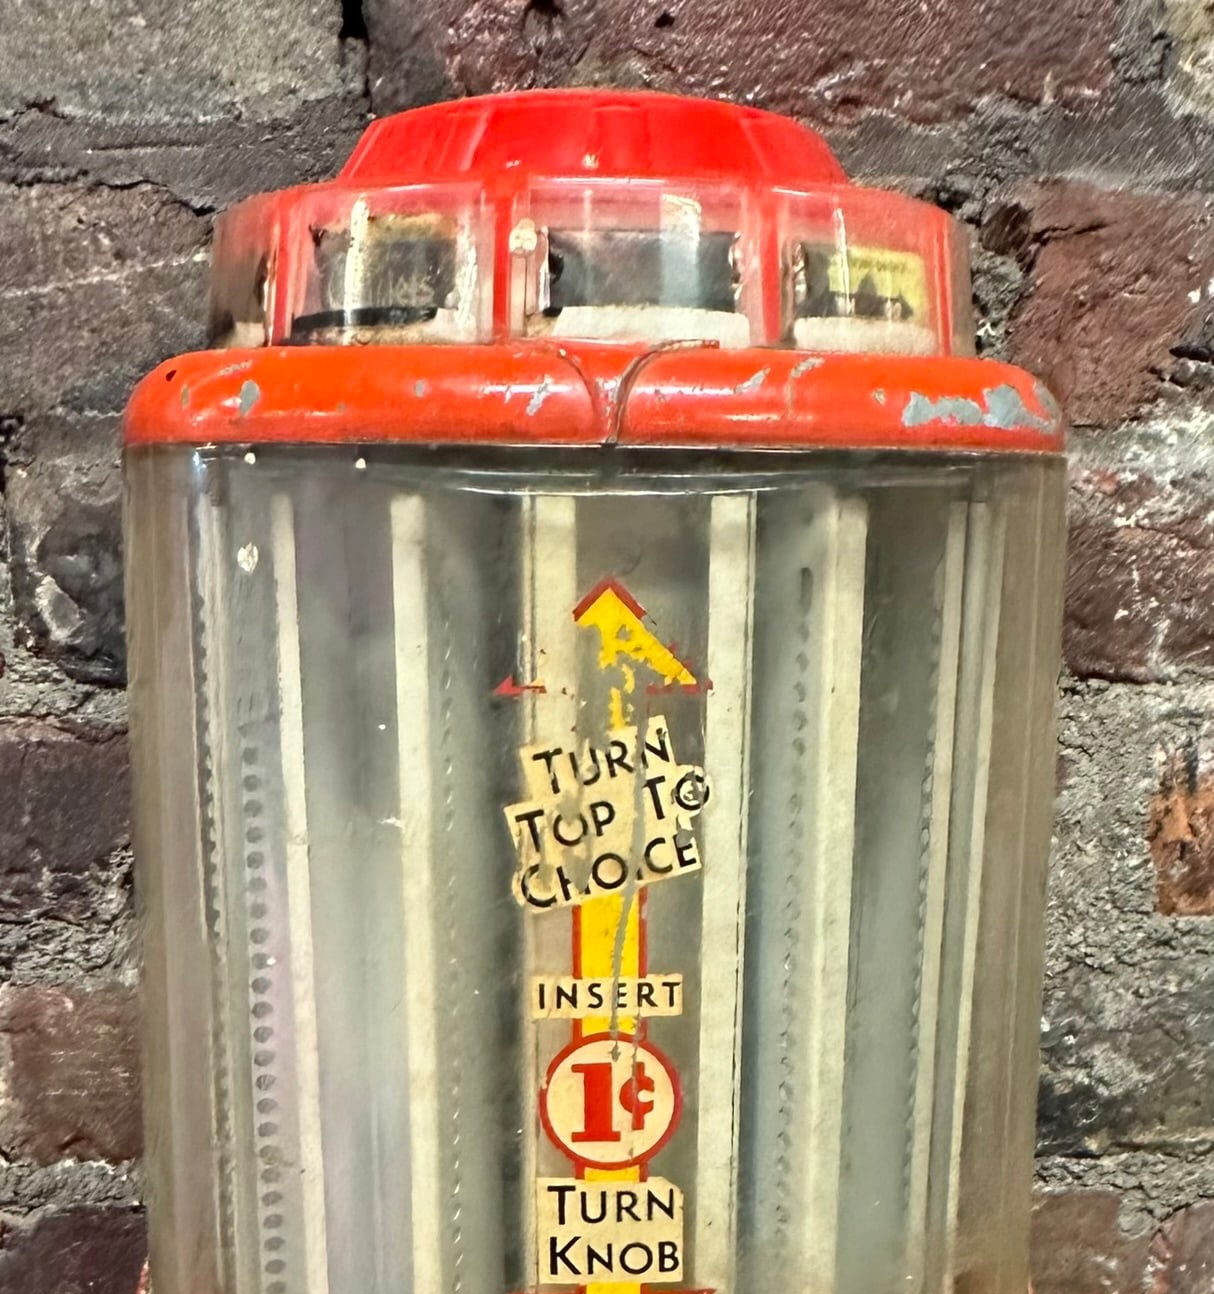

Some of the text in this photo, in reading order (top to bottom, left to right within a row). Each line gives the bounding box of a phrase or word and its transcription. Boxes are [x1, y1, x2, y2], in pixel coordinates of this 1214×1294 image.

[532, 728, 671, 795] TURN
[515, 769, 711, 853] TOP TO
[538, 981, 681, 1010] INSERT
[571, 1061, 655, 1142] 1¢
[547, 1185, 676, 1225] TURN
[549, 1235, 680, 1276] KNOB
